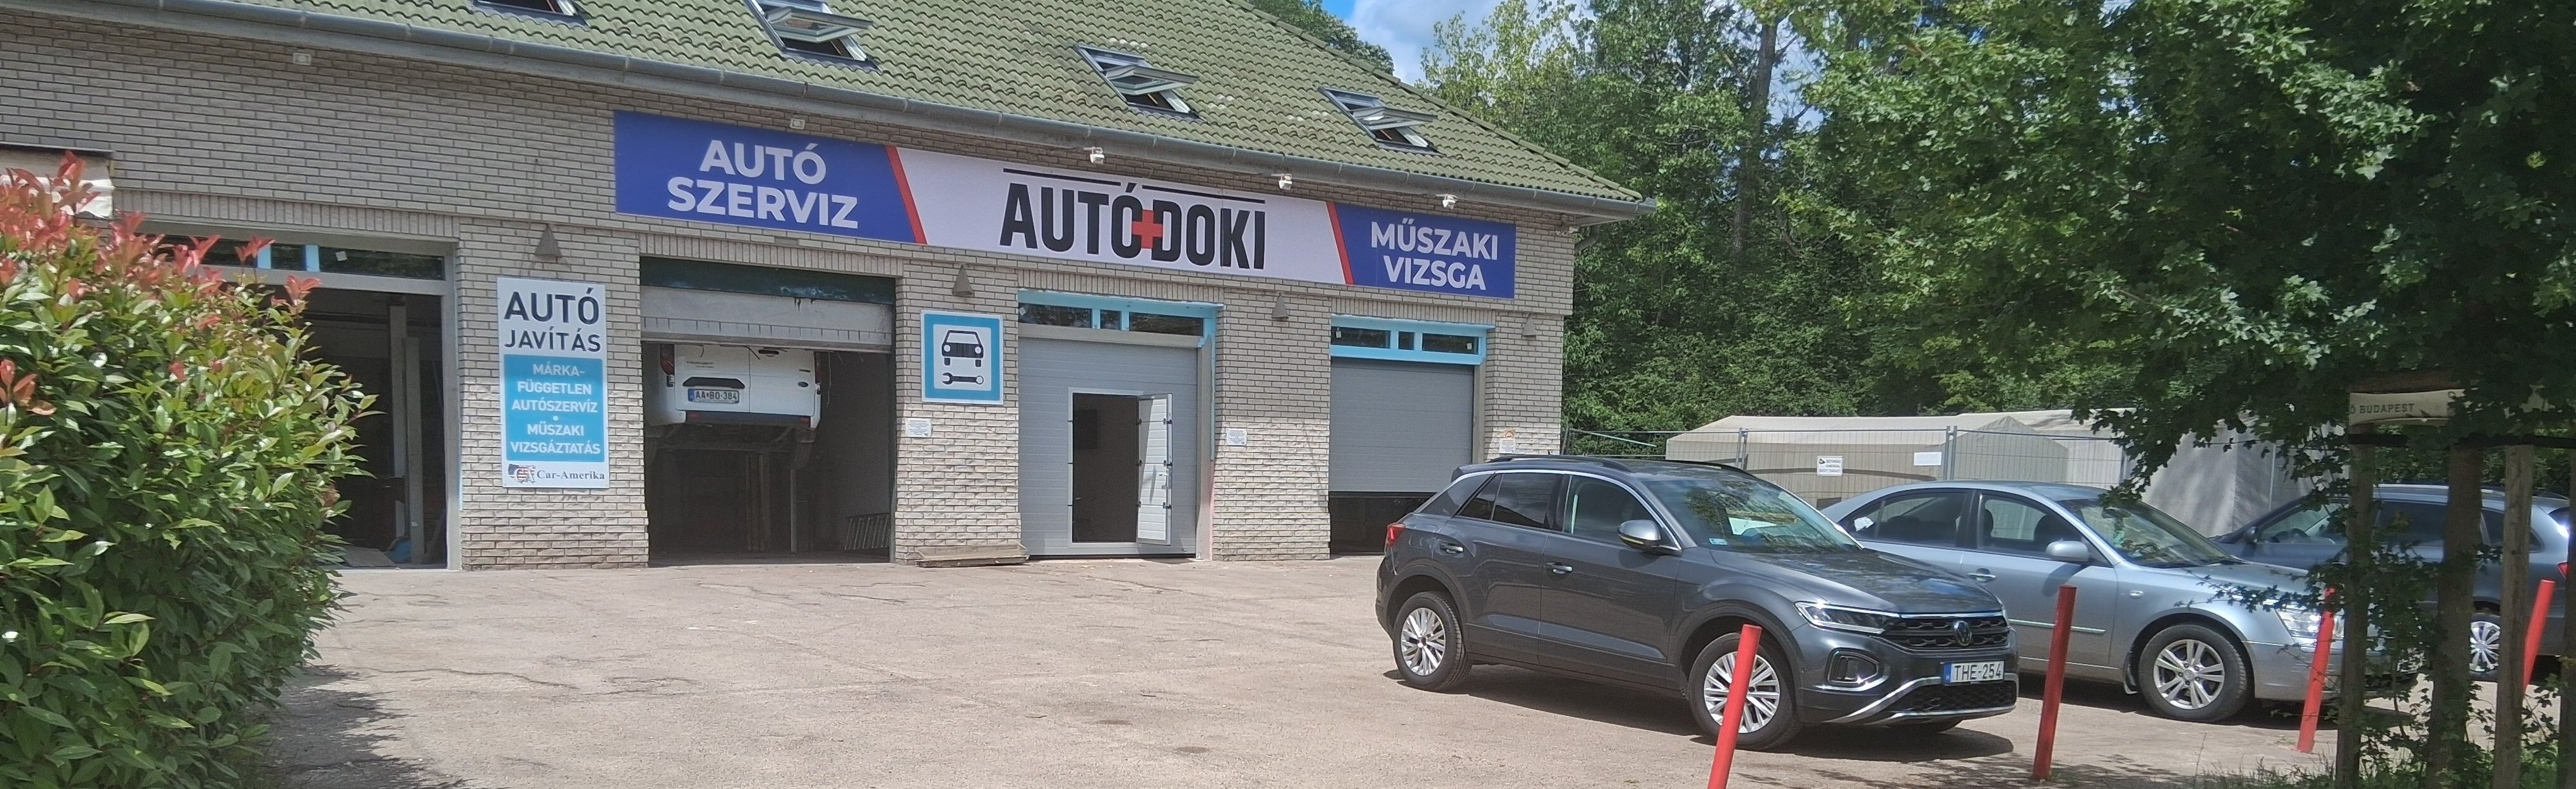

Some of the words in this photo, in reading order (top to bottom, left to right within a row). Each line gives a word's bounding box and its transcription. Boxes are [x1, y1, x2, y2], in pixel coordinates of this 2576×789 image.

[699, 139, 826, 184] AUTÓ
[667, 176, 858, 229] SZERVIZ
[1371, 218, 1498, 261] MŰSZAKI
[1383, 255, 1486, 290] VIZSGA
[503, 287, 600, 324] AUTÓ
[503, 326, 601, 352] JAVÍTÁS
[533, 361, 585, 377] MÁRKA-
[517, 379, 592, 395] FÜGGETLEN
[511, 397, 598, 413] AUTÓSZERVÍZ
[2359, 403, 2415, 414] BUDAPEST
[527, 420, 584, 436] MŰSZAKI
[510, 439, 601, 454] VIZSGÁZTATÁS
[537, 470, 605, 480] Car-Amerika
[1954, 663, 2001, 681] THE-254
